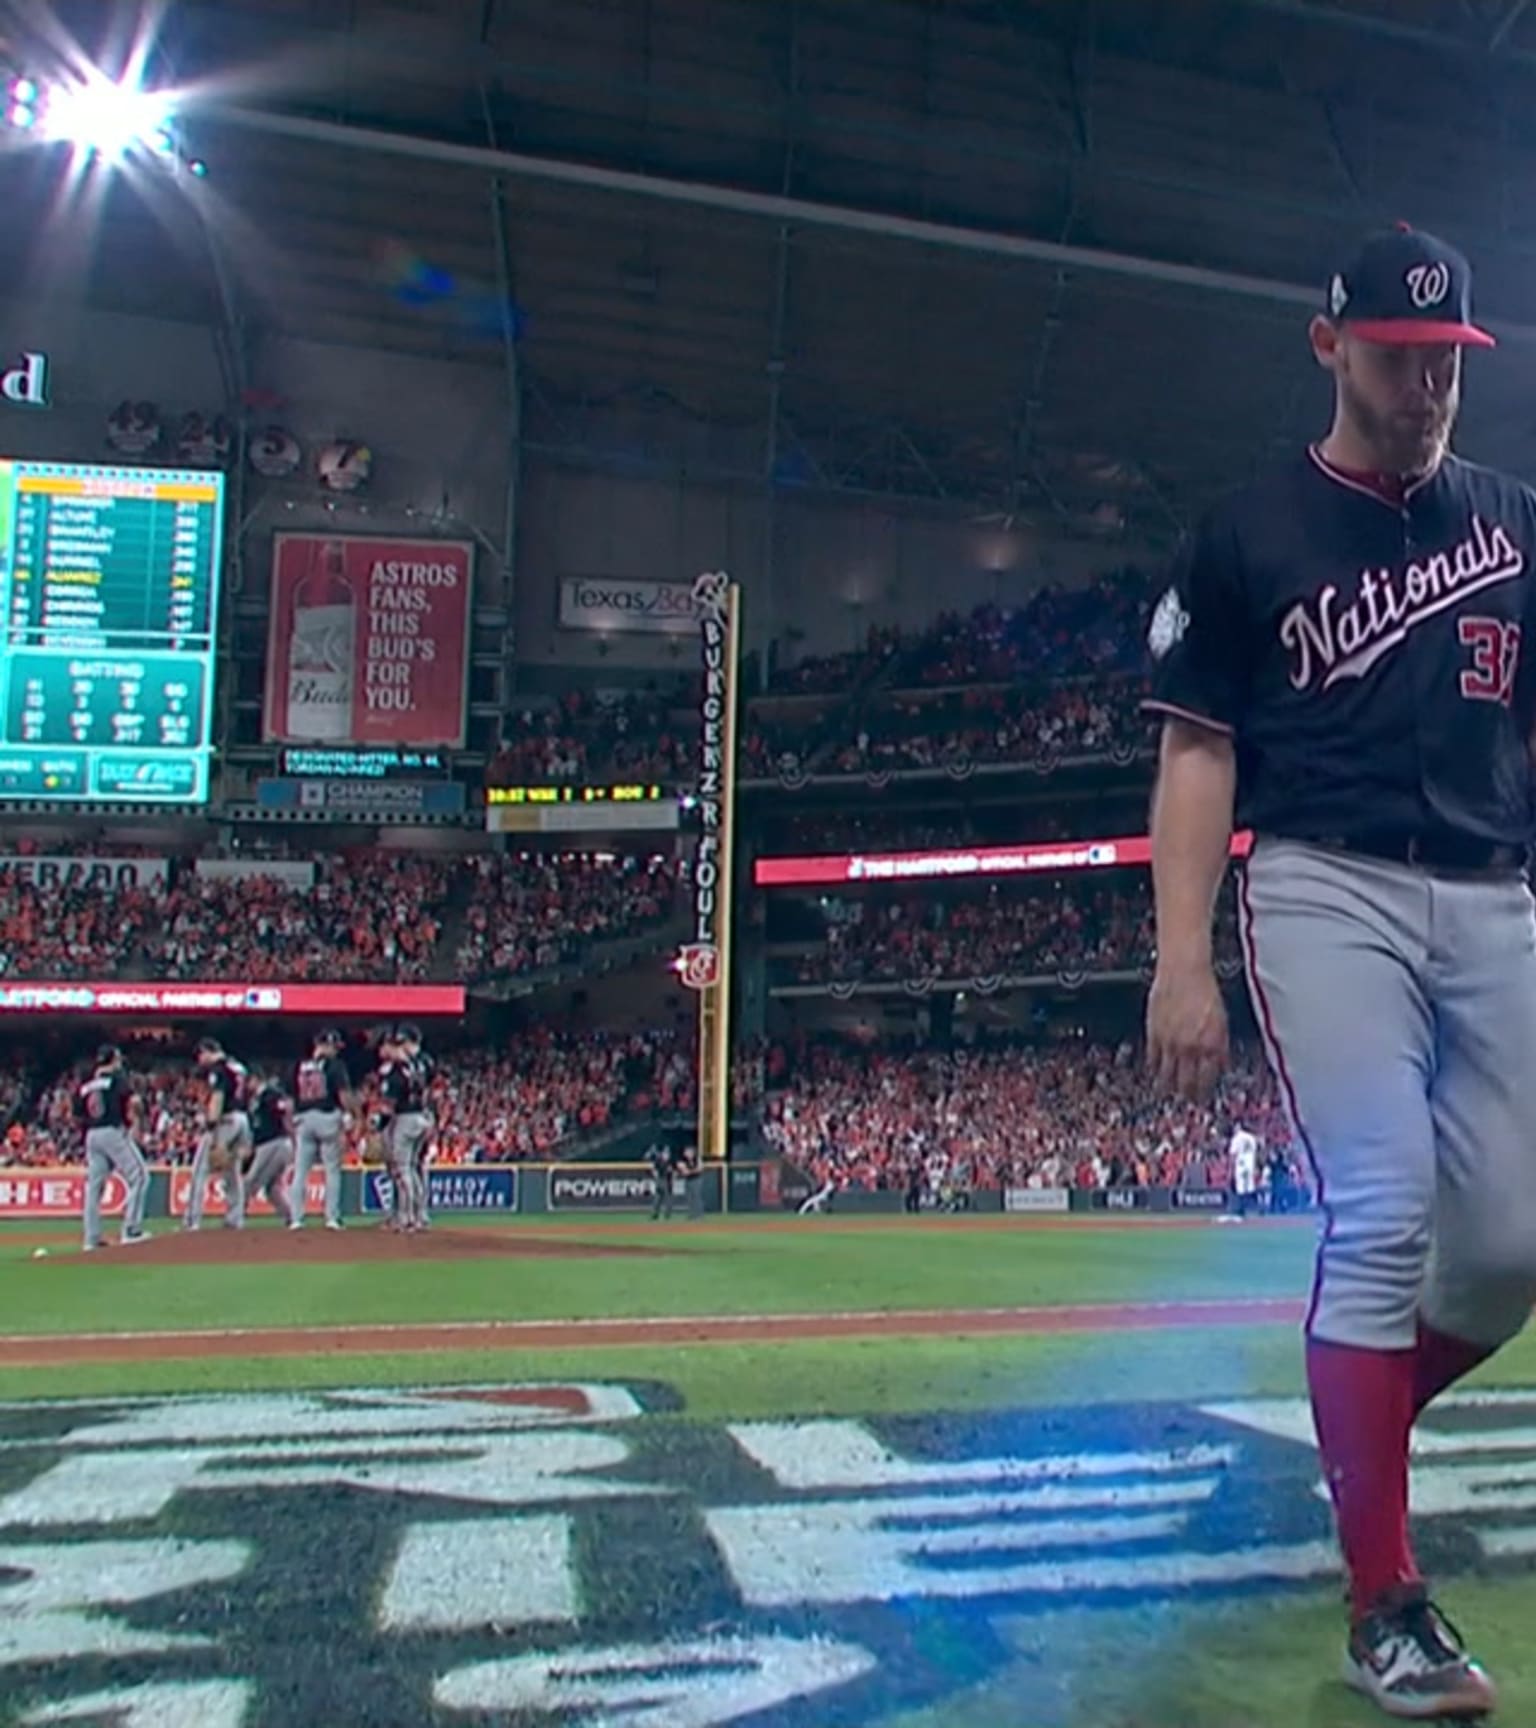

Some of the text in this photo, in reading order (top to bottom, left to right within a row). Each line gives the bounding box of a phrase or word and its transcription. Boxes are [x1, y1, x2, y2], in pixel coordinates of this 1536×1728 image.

[1406, 261, 1449, 308] W
[371, 561, 458, 588] ASTROS
[370, 586, 433, 614] FANS,
[571, 582, 645, 610] Texas
[1280, 514, 1518, 690] Nationals
[368, 610, 420, 635] THIS
[367, 636, 436, 661] BUD'S
[366, 662, 411, 685] FOR
[365, 686, 416, 711] YOU.
[327, 782, 423, 798] CHAMPION
